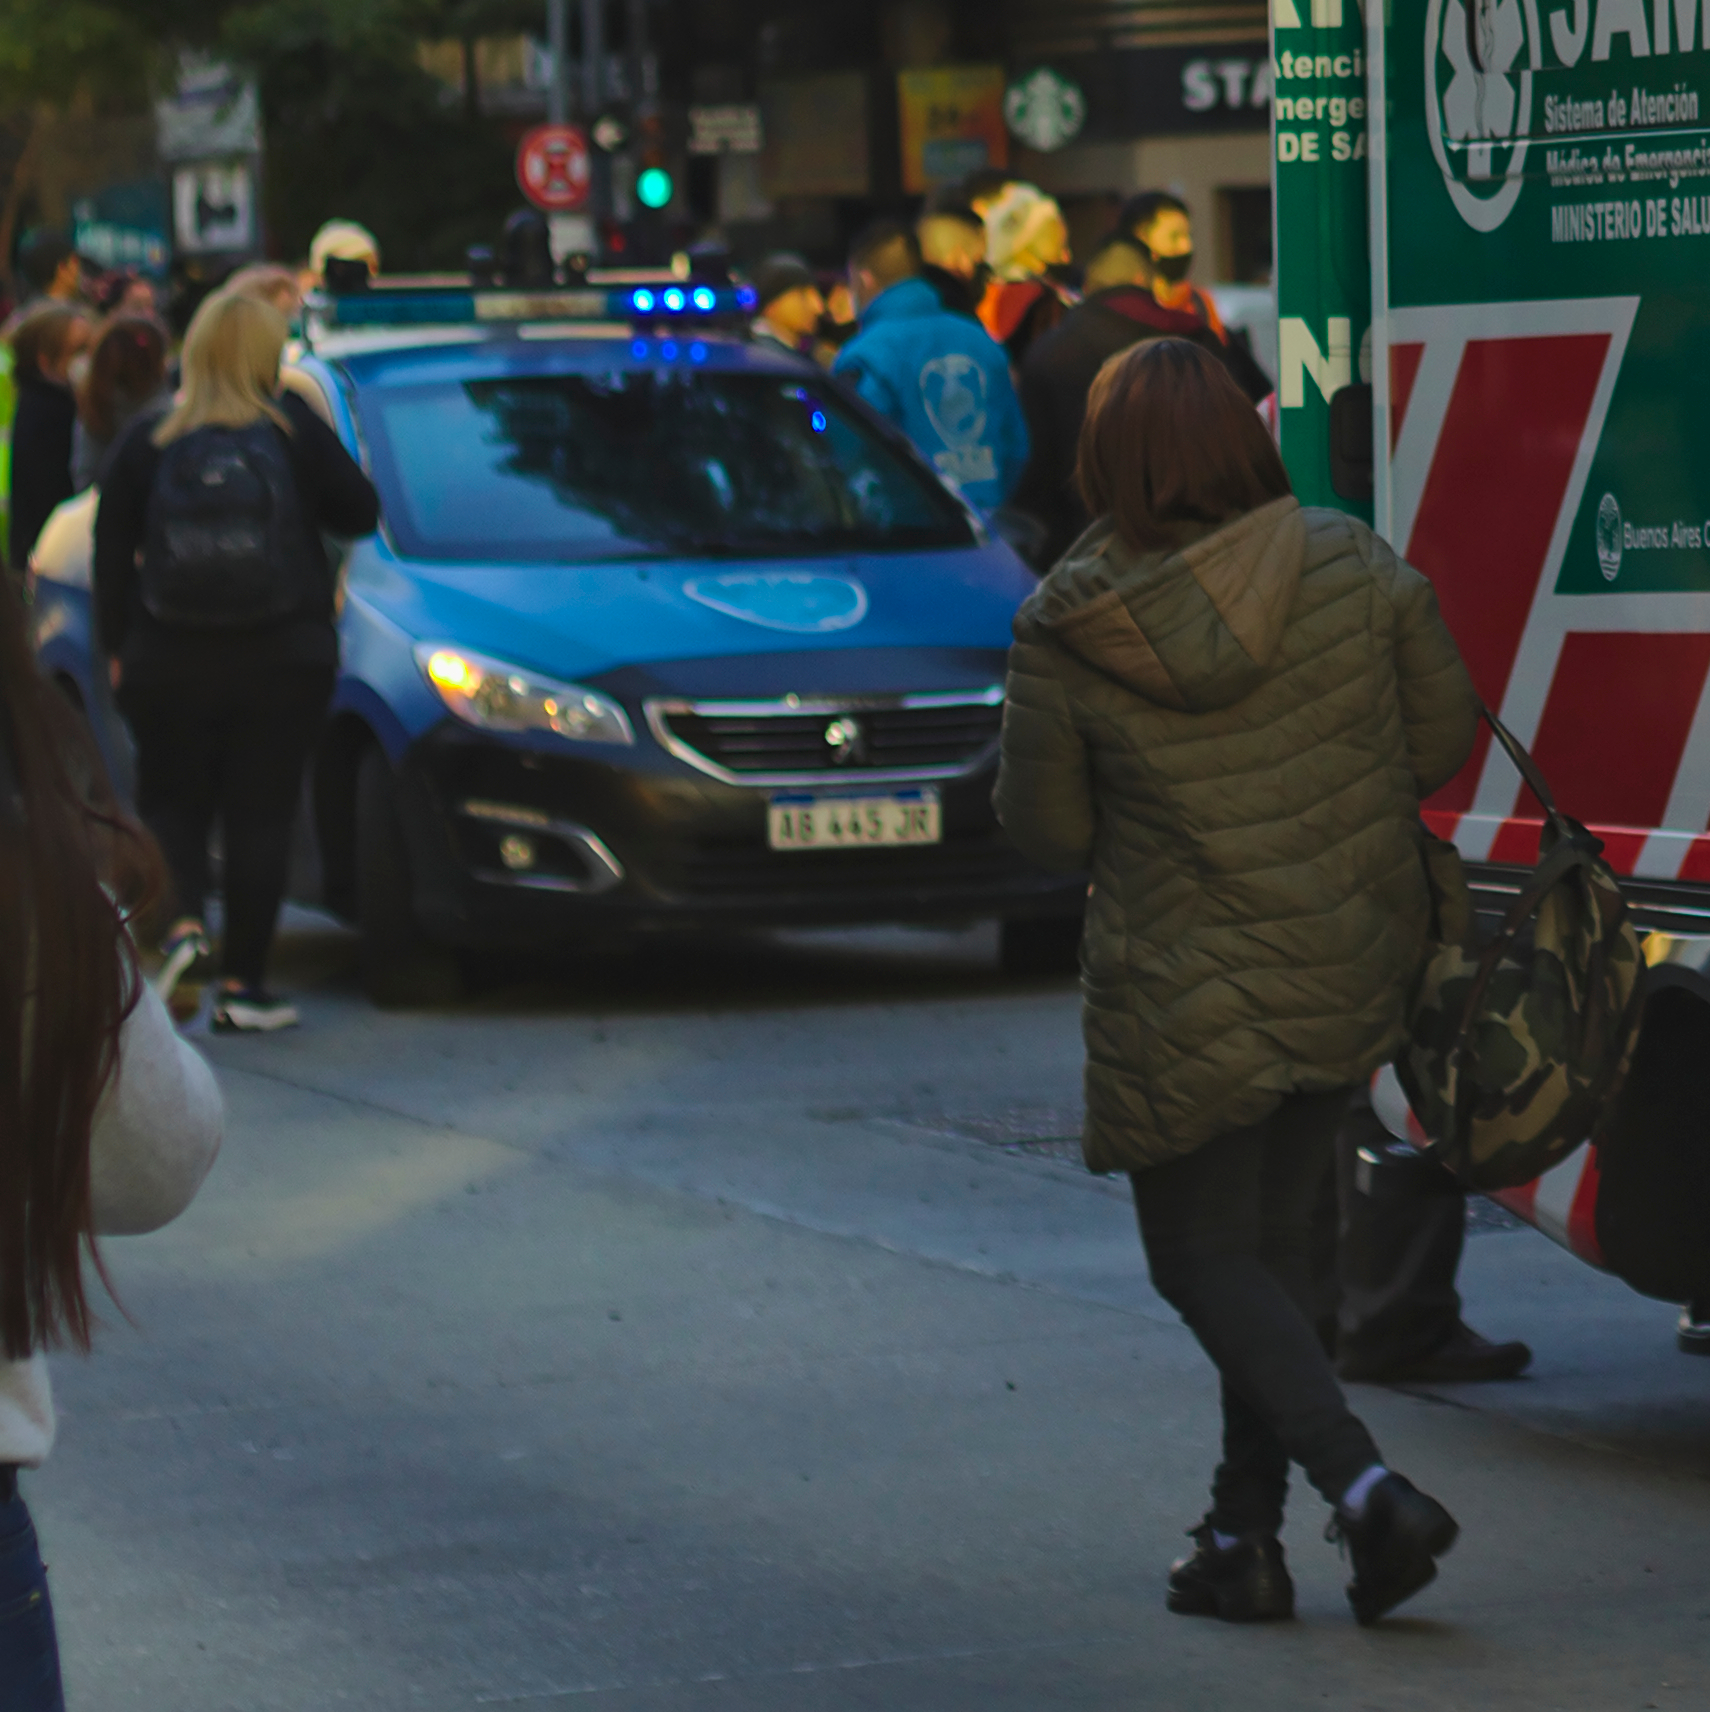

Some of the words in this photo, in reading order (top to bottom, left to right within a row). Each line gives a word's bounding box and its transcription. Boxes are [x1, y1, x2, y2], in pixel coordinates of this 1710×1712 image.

[1544, 94, 1603, 133] Sistema
[1607, 90, 1627, 126] de
[1630, 82, 1699, 125] Atención
[1278, 131, 1319, 162] DE
[1551, 200, 1641, 243] MINISTERIO
[1645, 198, 1668, 237] DE
[1623, 521, 1668, 550] Buenos
[1670, 520, 1701, 548] Aires
